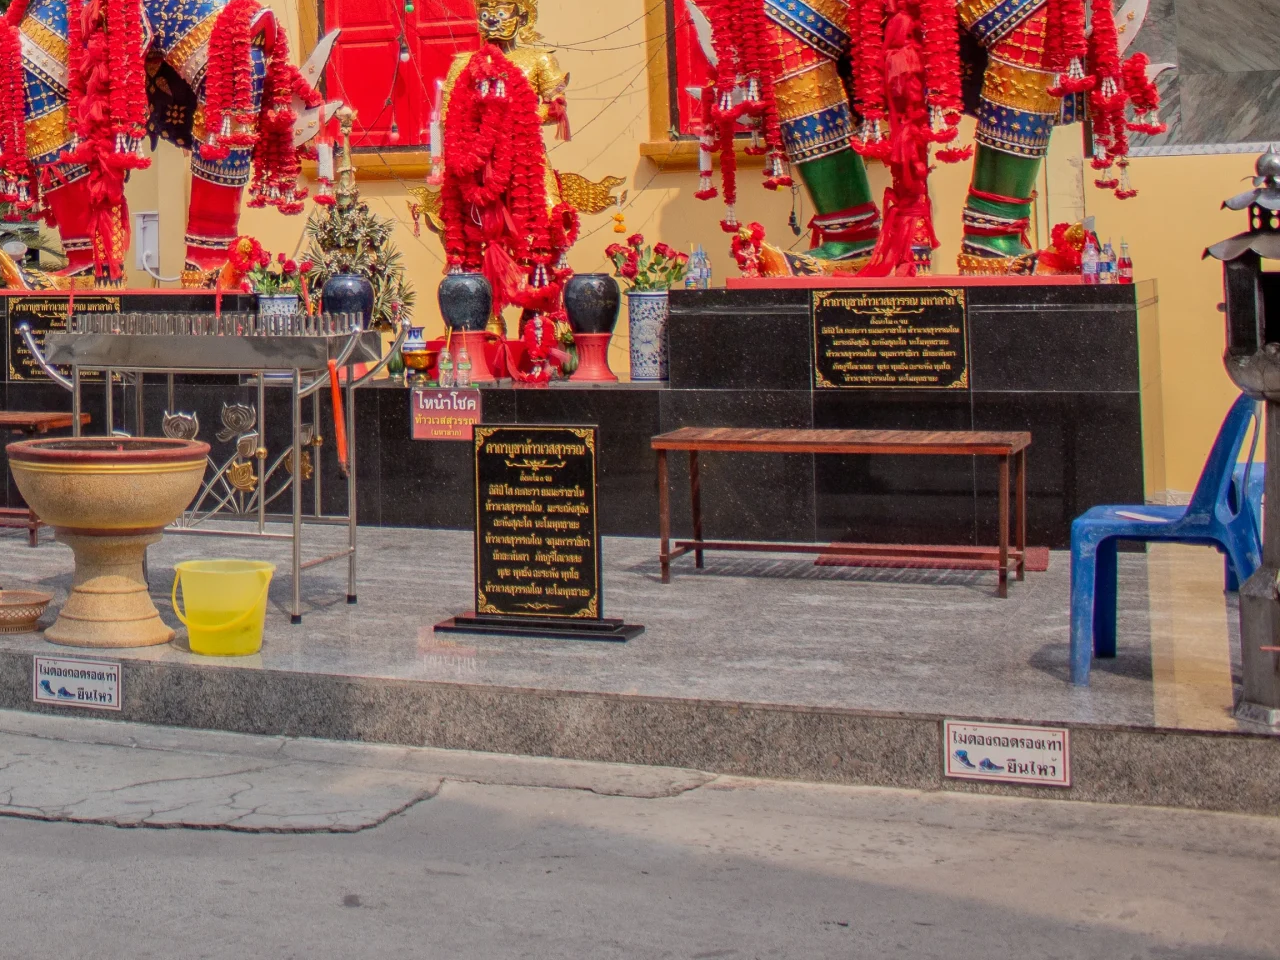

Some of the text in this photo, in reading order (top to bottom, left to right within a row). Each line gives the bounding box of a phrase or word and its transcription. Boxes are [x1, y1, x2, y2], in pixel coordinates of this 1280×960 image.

[823, 294, 955, 310] คาถาบูชาท้าวเวสสุวรรณ มหาลาภ
[415, 413, 478, 429] ท้าวเวสสุวรรณ
[486, 438, 585, 459] คาถาบูชาท้าวเวสสุวรรณ
[39, 661, 117, 682] ไม่ต้องถอดรองเท้า
[77, 687, 113, 703] ยืนไหว้
[952, 727, 1062, 751] ไม่ต้องถอดรองเท้า
[1006, 756, 1058, 777] ยืนไหว้
